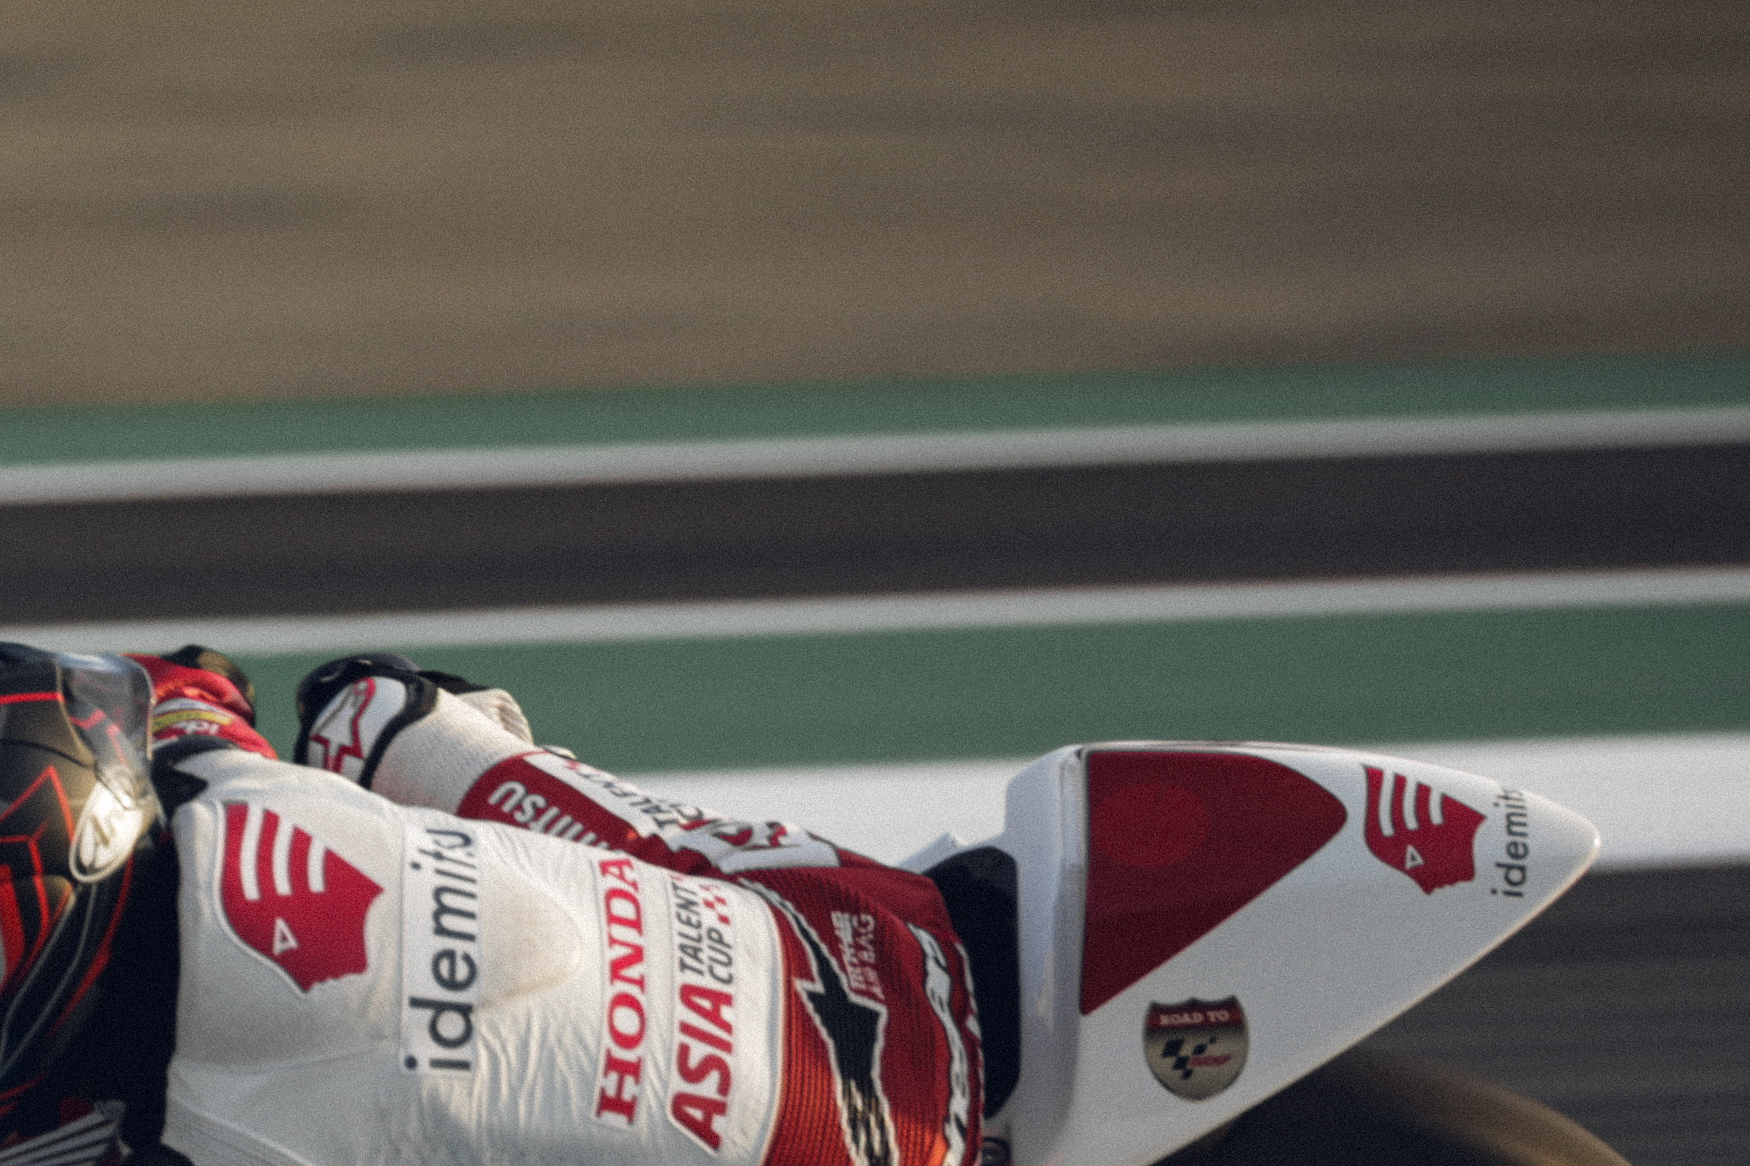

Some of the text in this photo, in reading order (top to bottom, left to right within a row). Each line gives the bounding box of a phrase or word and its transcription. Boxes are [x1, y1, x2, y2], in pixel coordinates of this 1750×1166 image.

[595, 857, 646, 1126] HONDA
[669, 881, 734, 1152] ASIA TALENT
[706, 927, 733, 986] CUP
